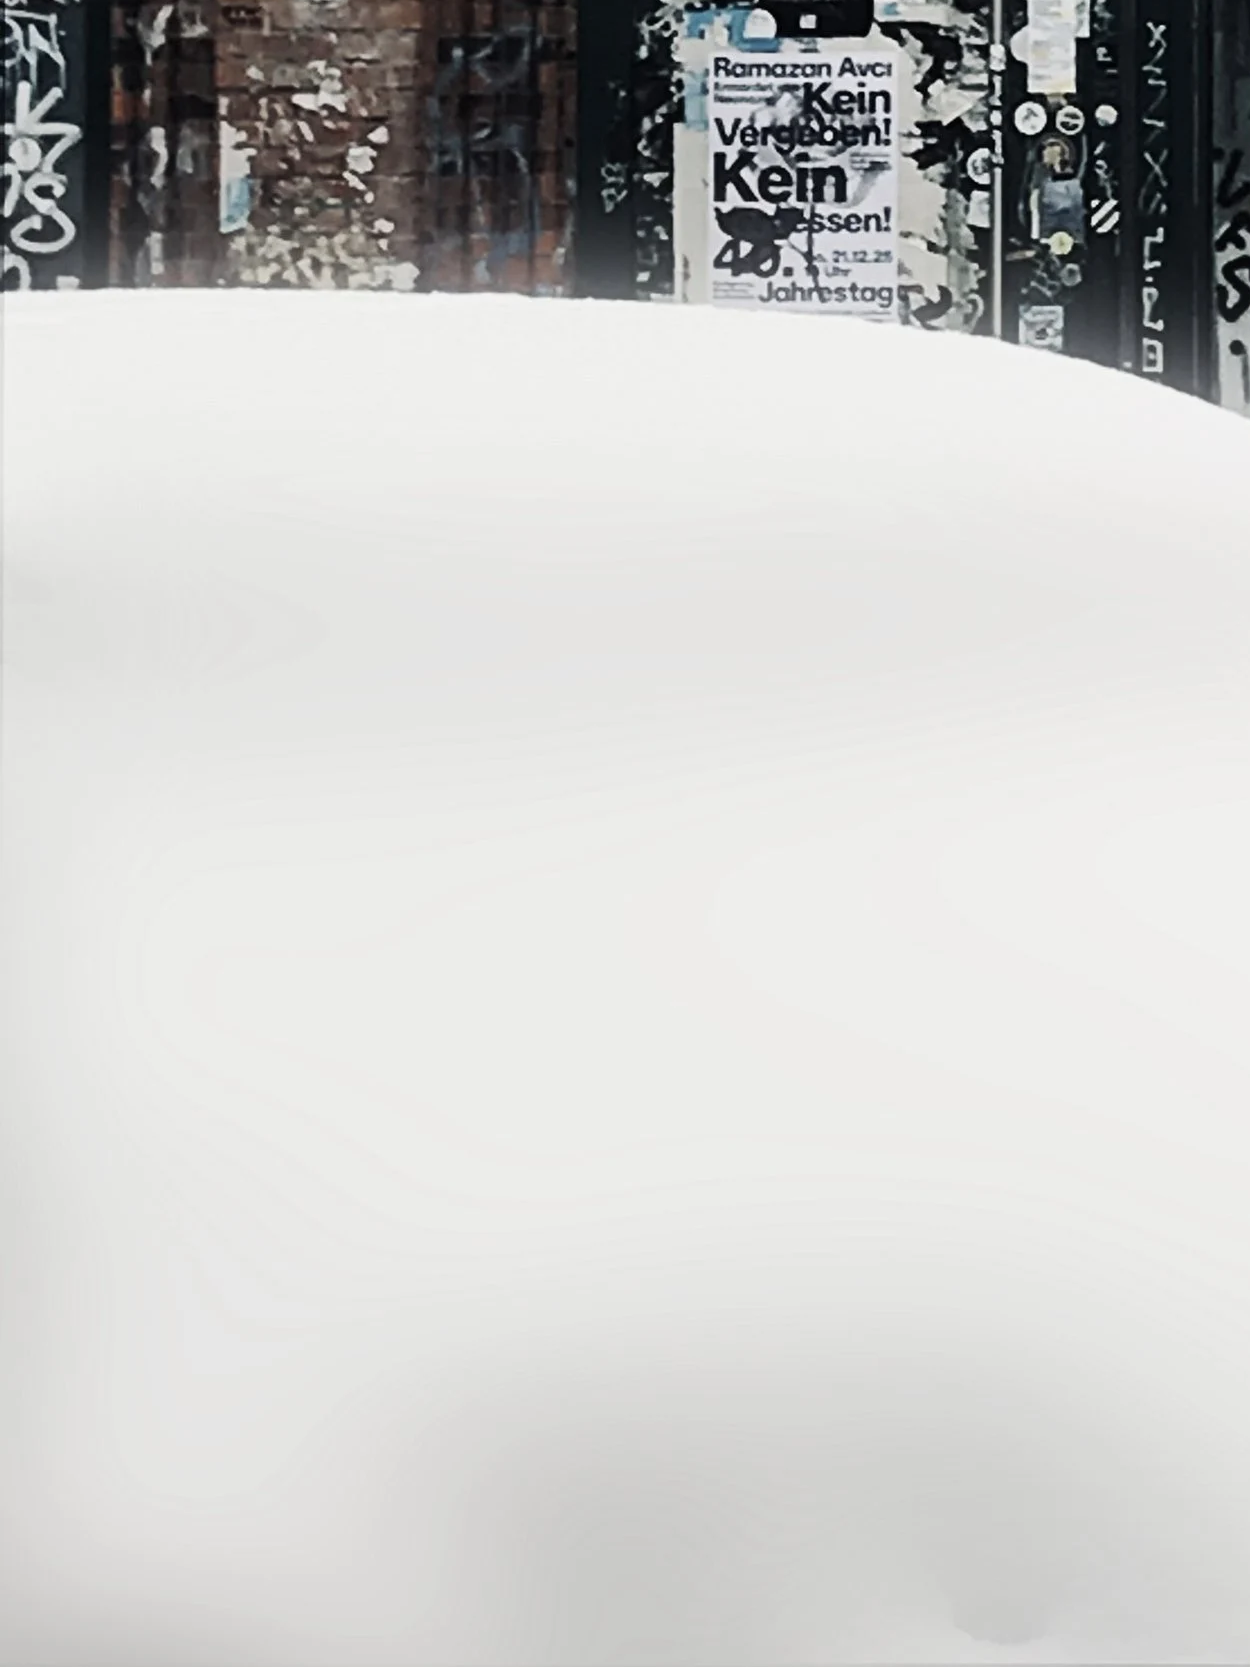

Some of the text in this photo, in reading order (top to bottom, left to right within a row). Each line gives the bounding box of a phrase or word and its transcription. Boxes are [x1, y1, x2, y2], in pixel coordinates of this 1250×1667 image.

[714, 57, 831, 78] Ramazan
[803, 82, 891, 114] Kein
[714, 118, 891, 154] Vergeben!
[713, 151, 847, 203] Kein
[759, 281, 893, 308] Jahrestag
